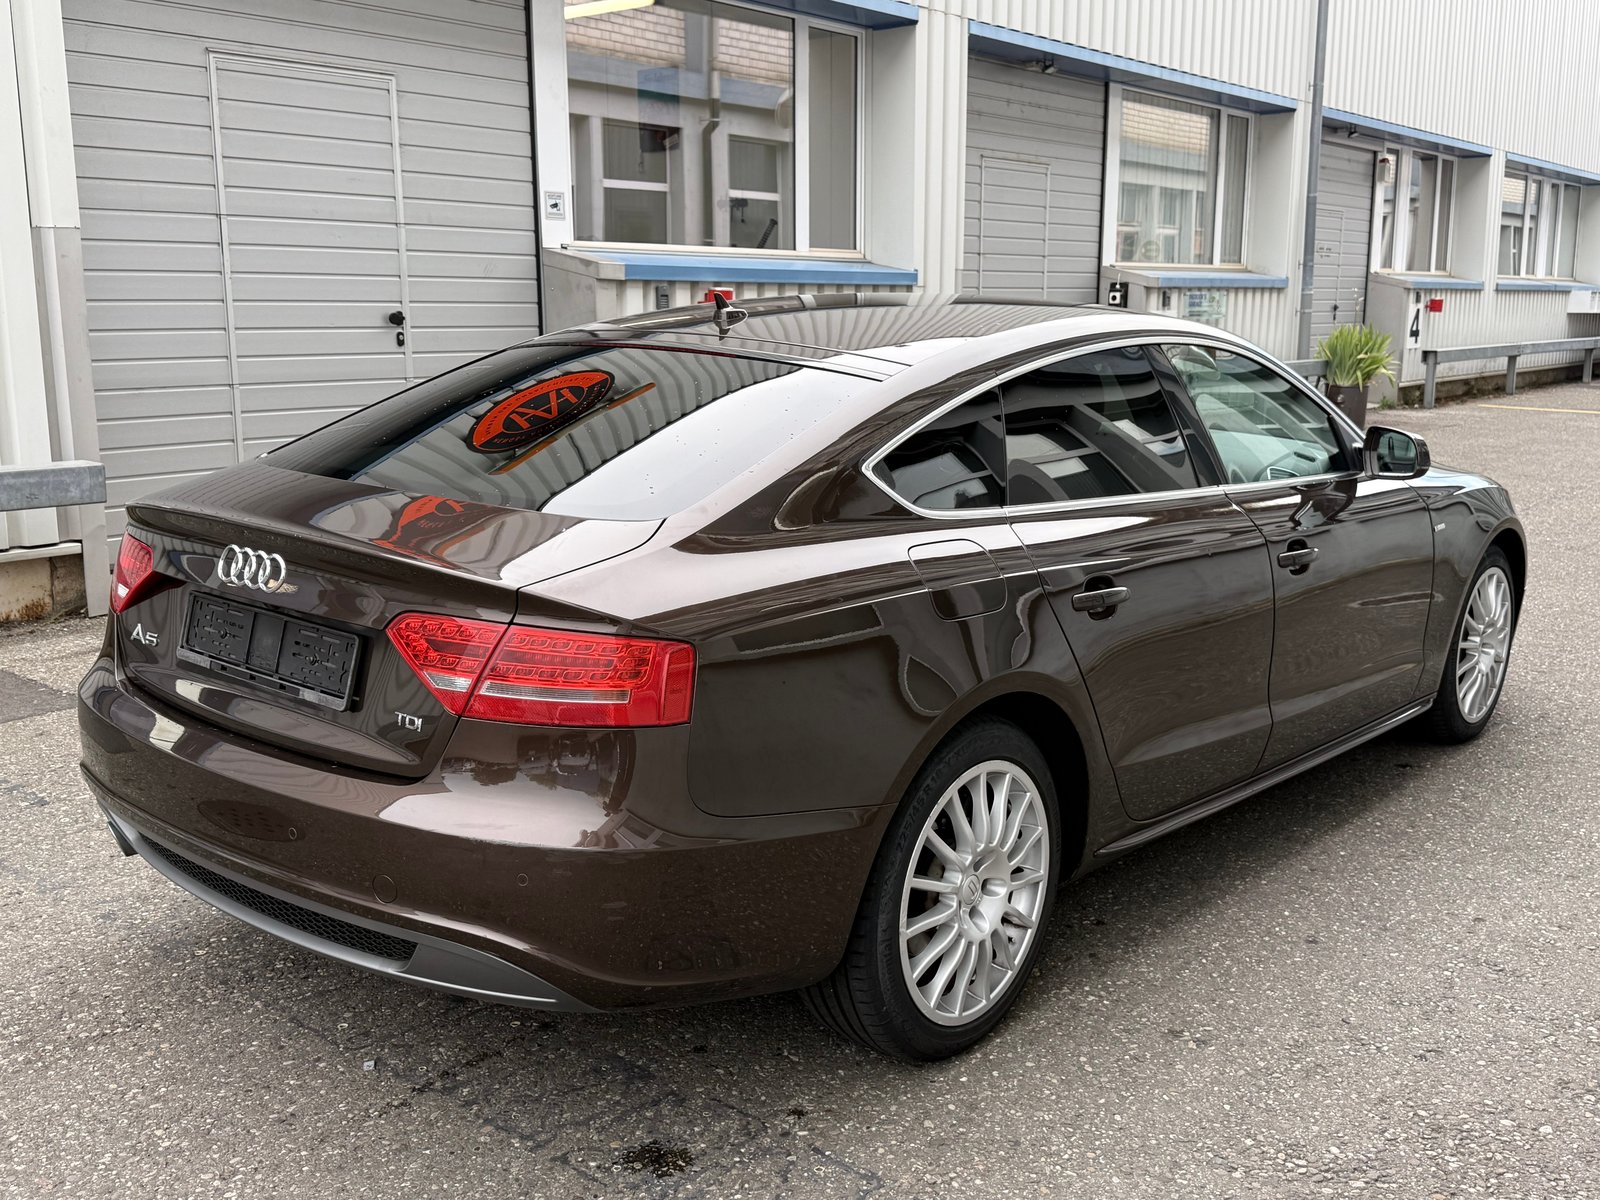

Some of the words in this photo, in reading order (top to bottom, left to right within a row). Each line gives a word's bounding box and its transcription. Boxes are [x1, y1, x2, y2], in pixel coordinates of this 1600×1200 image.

[1409, 308, 1420, 344] 4
[130, 623, 159, 646] A5
[394, 711, 422, 732] TDI
